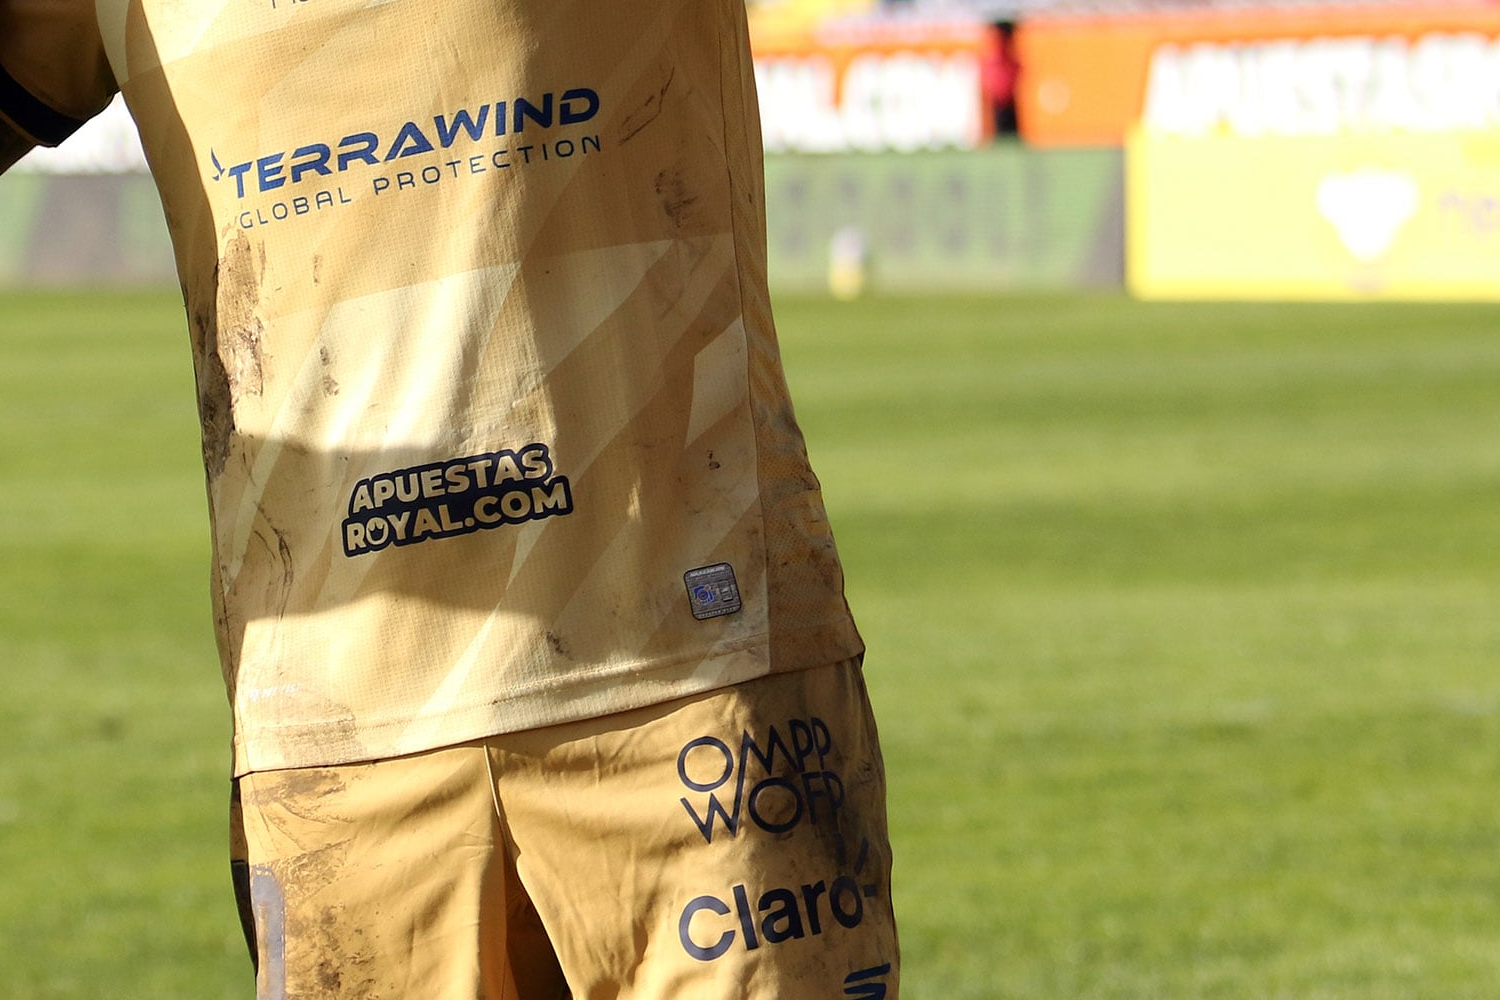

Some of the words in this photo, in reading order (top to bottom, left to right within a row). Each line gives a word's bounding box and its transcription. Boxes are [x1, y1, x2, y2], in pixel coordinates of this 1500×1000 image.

[227, 87, 600, 199] TERRAWIND
[240, 186, 352, 230] GLOBAL
[373, 134, 602, 196] PROTECTION
[346, 482, 568, 551] ROYAL.COM
[352, 449, 548, 514] APUESTAS
[678, 875, 863, 962] Claro
